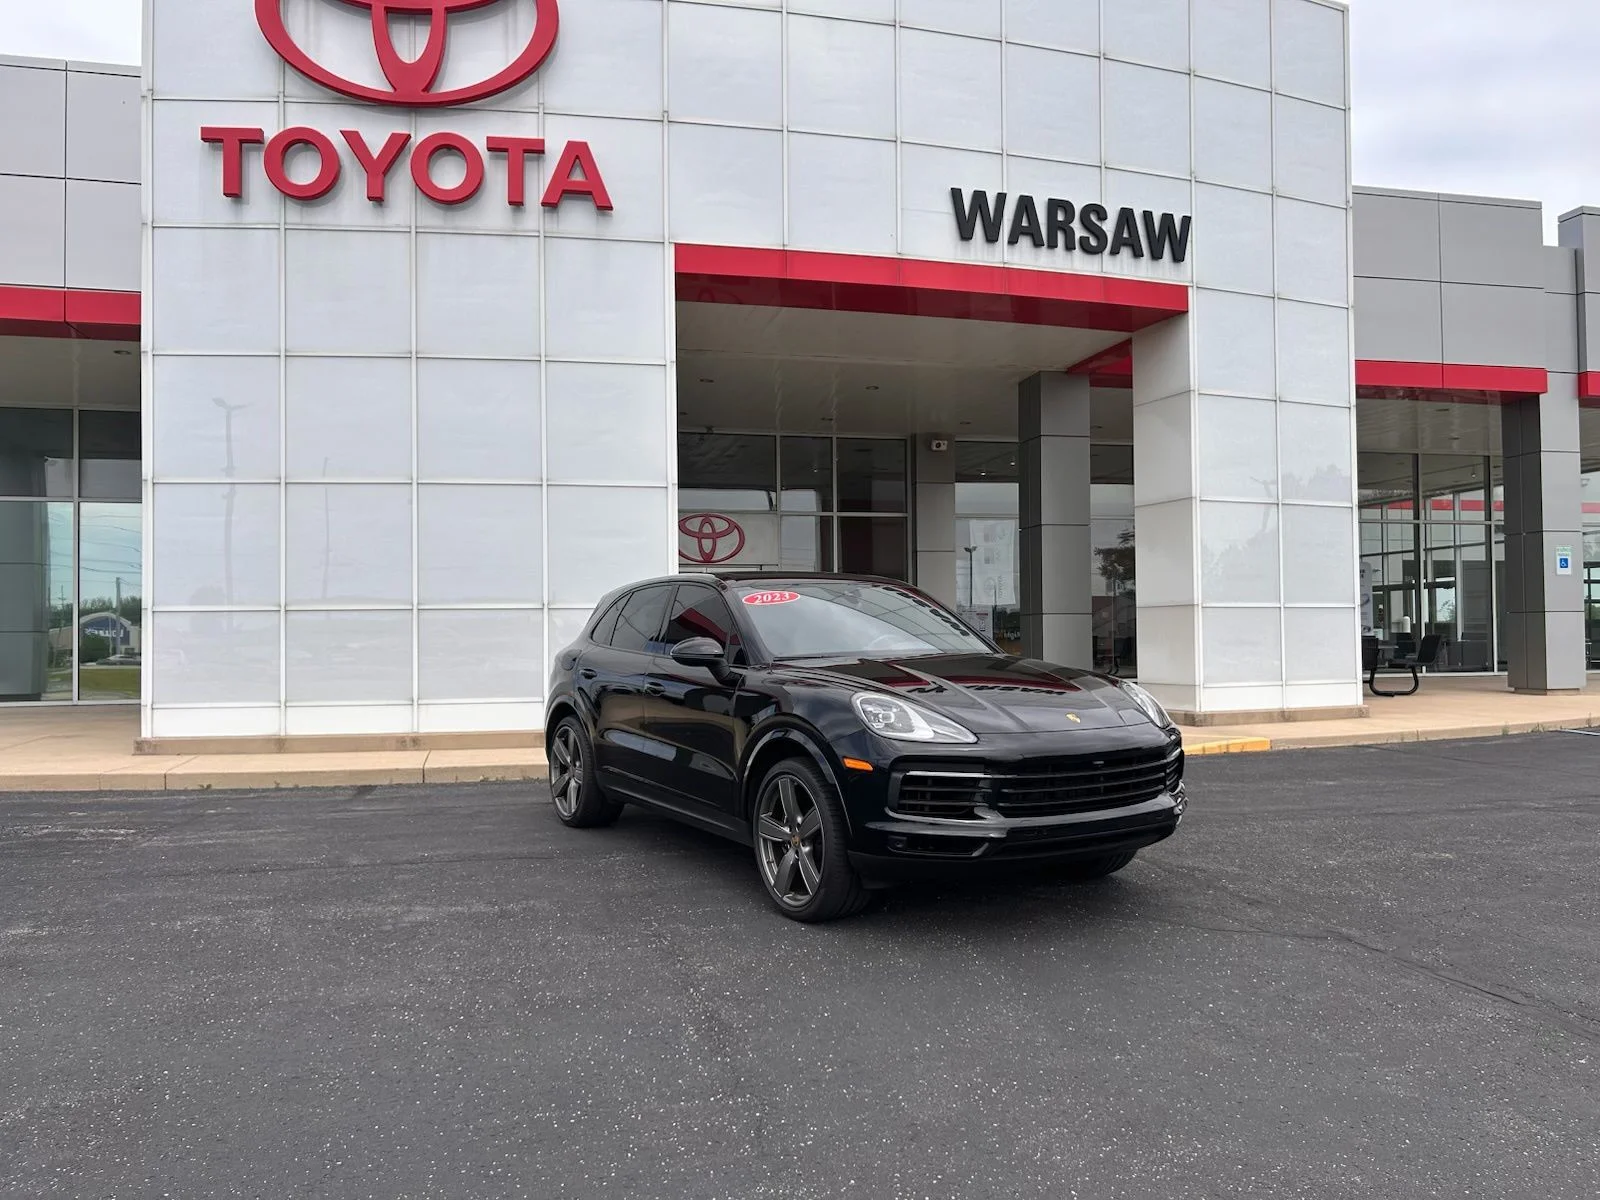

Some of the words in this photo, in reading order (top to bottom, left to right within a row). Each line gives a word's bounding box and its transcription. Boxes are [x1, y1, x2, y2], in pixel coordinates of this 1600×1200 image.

[201, 126, 613, 211] TOYOTA
[951, 187, 1191, 262] WARSAW
[754, 592, 790, 604] 2023
